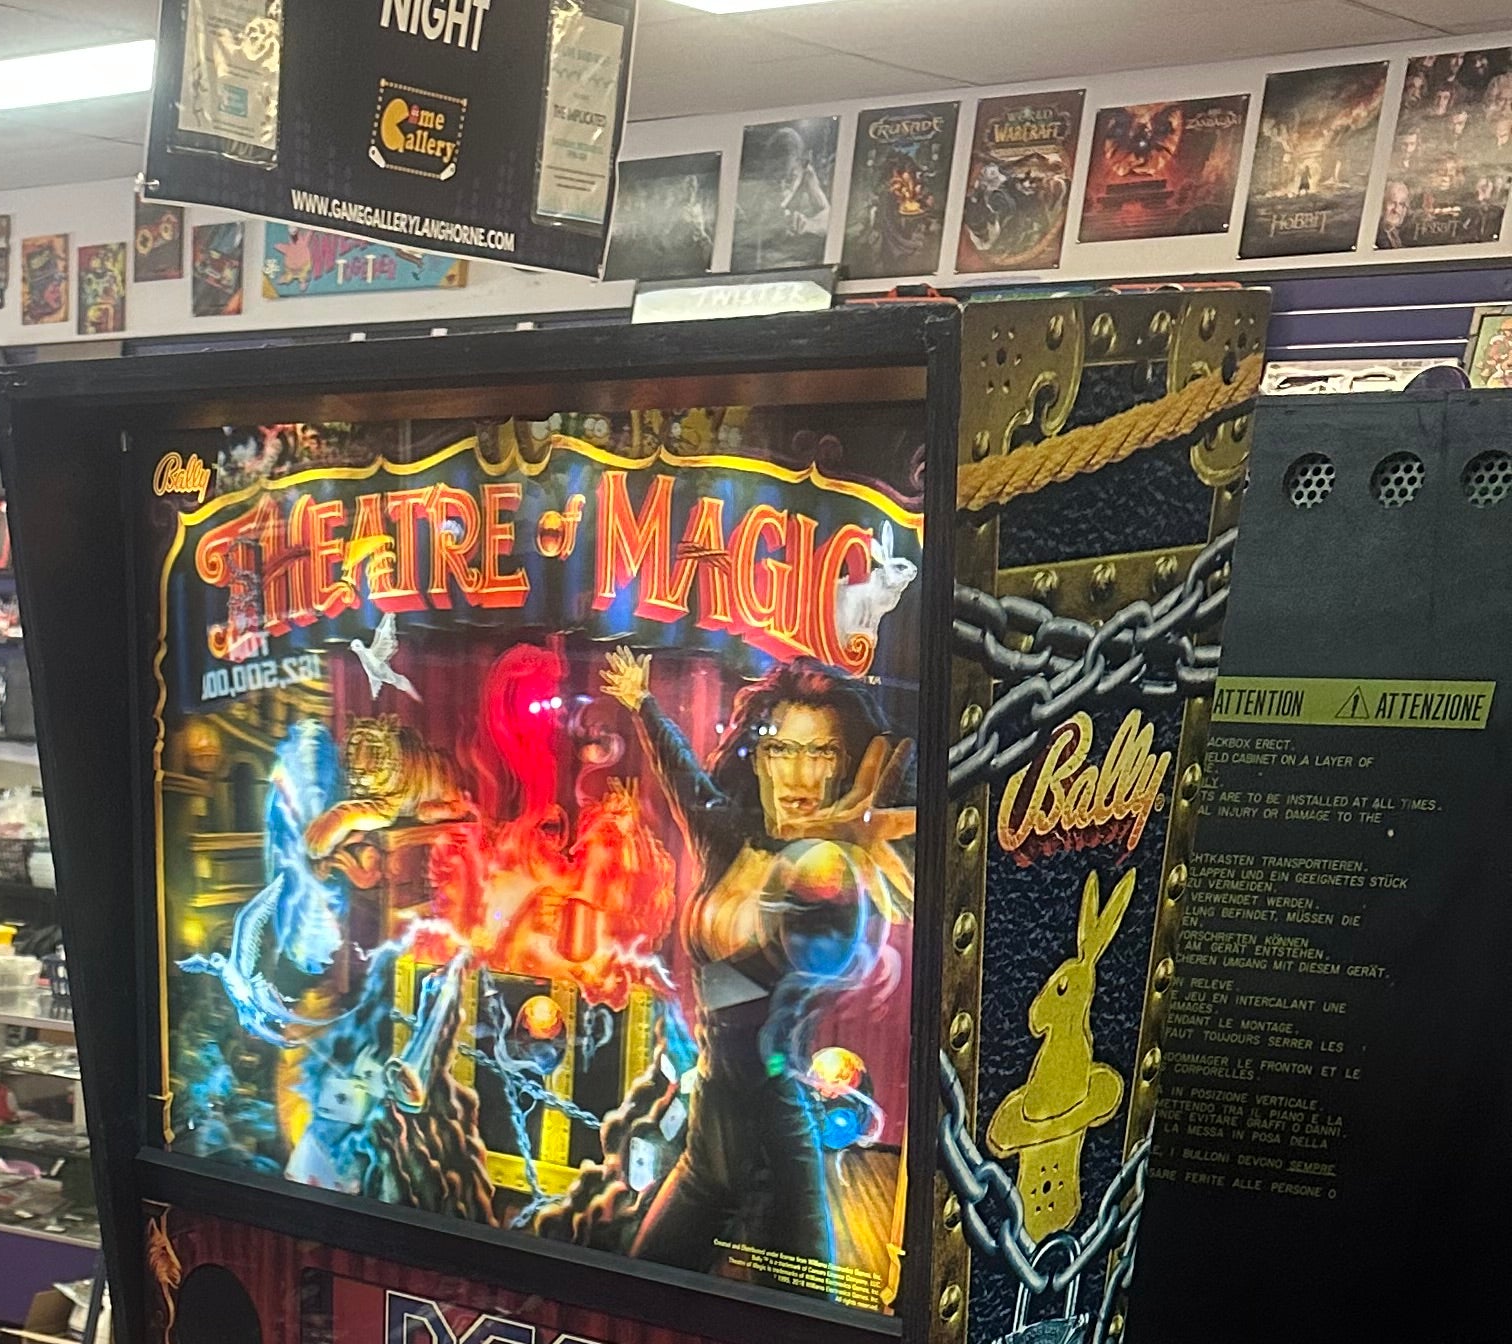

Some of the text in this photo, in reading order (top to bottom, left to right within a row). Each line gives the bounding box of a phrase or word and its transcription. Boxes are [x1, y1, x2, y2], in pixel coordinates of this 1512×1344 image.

[1006, 108, 1053, 122] WORLD
[869, 115, 945, 138] CRUSADE
[993, 122, 1062, 144] WARCRAFT
[290, 189, 515, 252] WWW.GAMEGALLERYLANGHORNE.COM
[1270, 211, 1330, 238] HOBBIT
[152, 452, 214, 502] Bally
[195, 470, 877, 678] THEATRE of MAGIC
[1213, 690, 1487, 722] ATTENTION ATTENZIONE
[1208, 738, 1251, 749] ACKBOX
[1232, 753, 1374, 768] CABINET ON A LAYER OF
[997, 709, 1171, 853] Bally
[1220, 792, 1442, 811] ARE TO BE INSTALLED AT ALL TIMES.
[1218, 807, 1382, 823] INJURY OR DAMAGE TO THE
[1241, 869, 1408, 889] UND EIN GEEIGNETES STÜCK
[1192, 892, 1259, 906] VERWENDET
[1287, 909, 1335, 925] MÜSSEN
[1341, 915, 1361, 926] DIE
[1273, 959, 1295, 971] MIT
[1299, 960, 1341, 974] DIESEM
